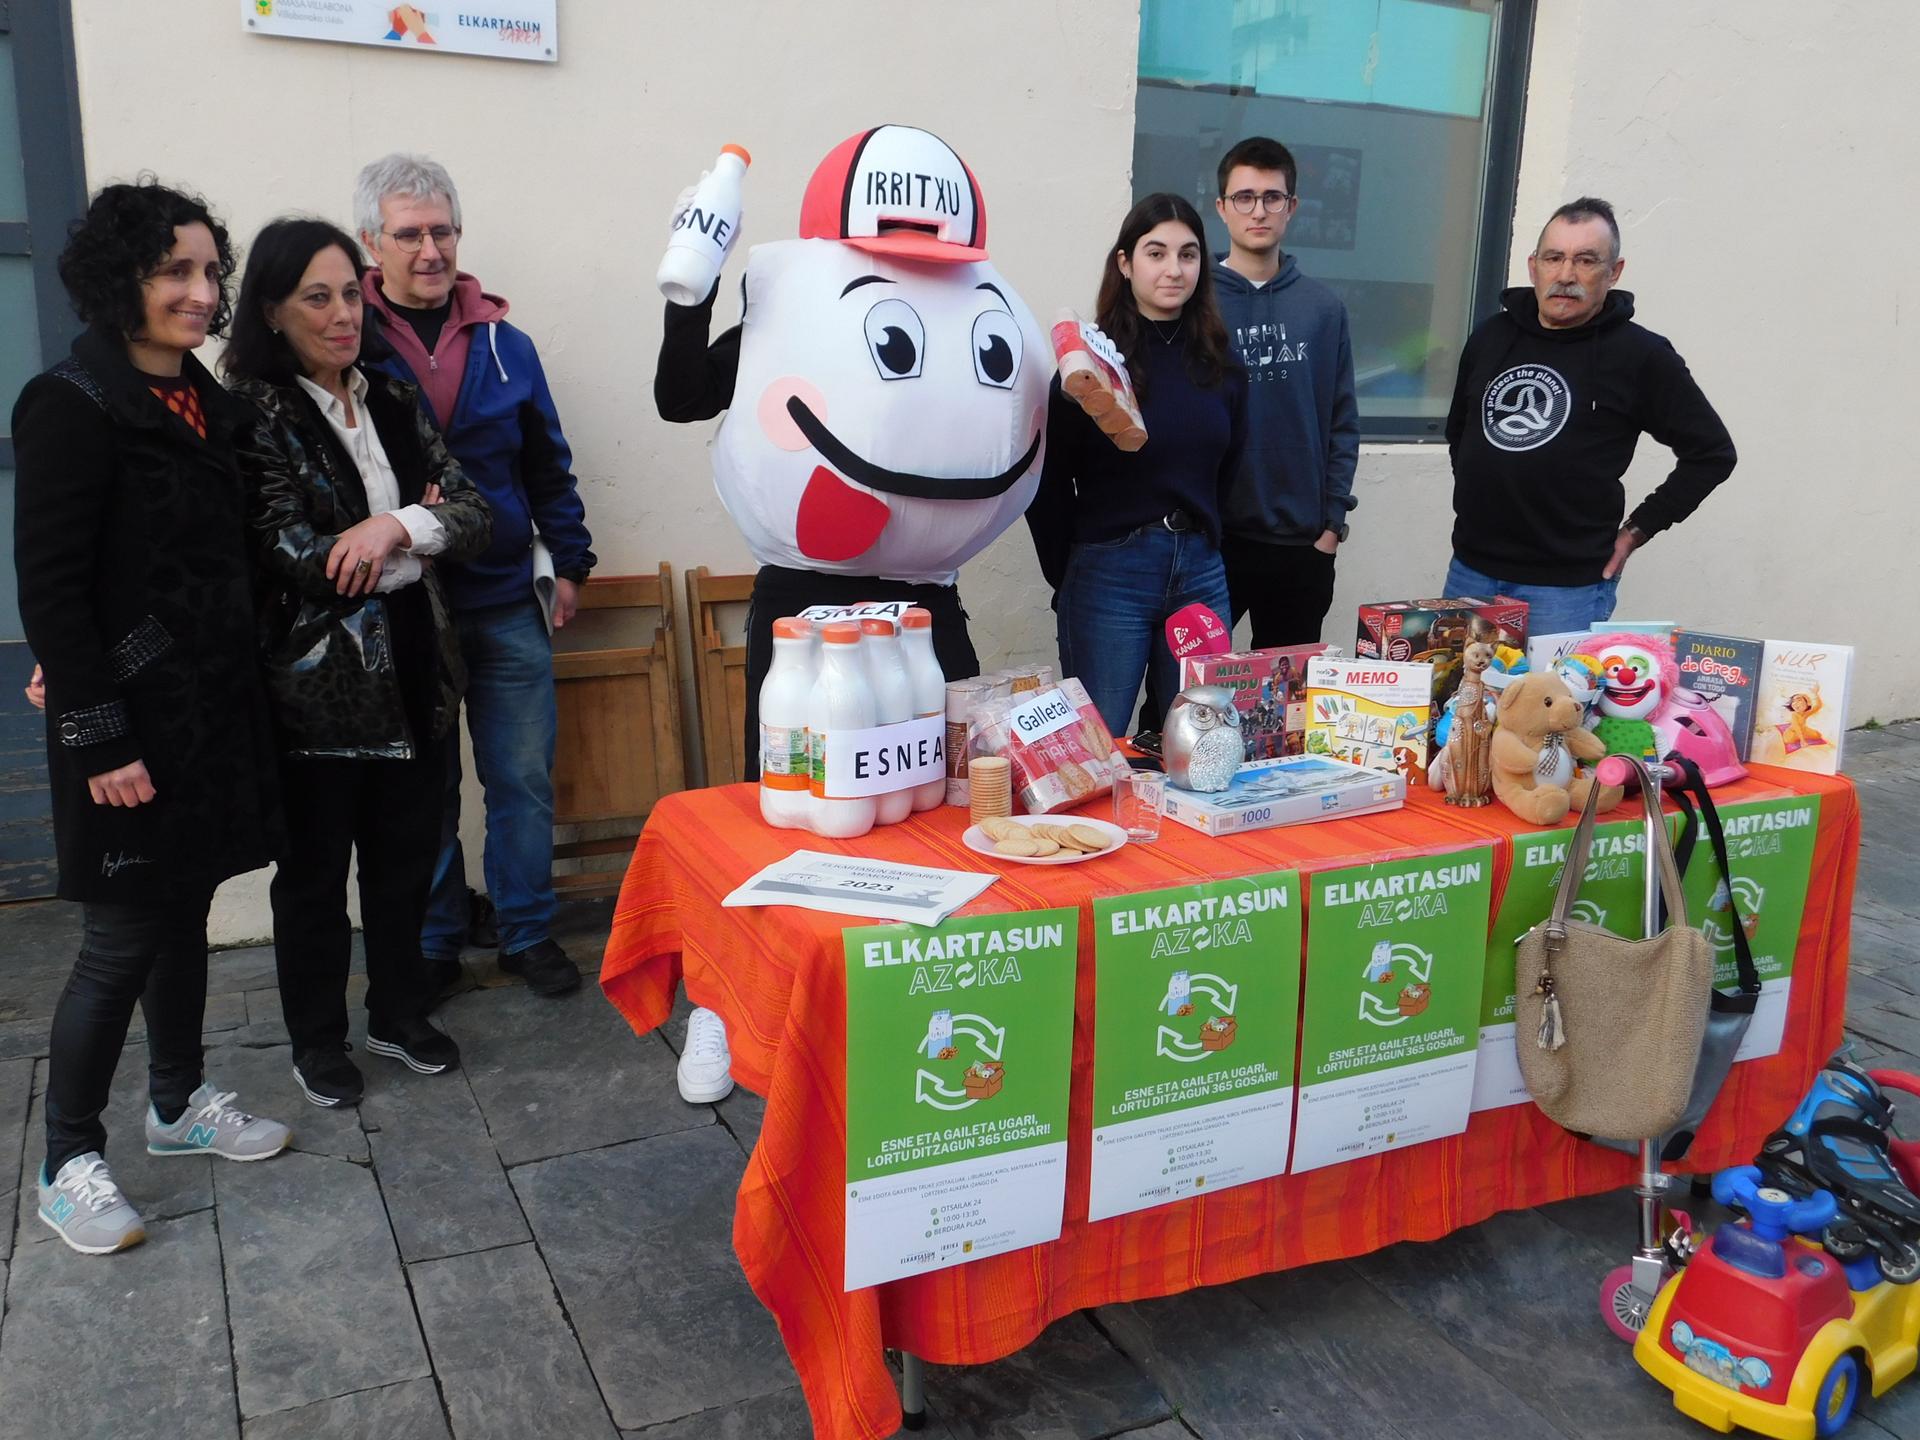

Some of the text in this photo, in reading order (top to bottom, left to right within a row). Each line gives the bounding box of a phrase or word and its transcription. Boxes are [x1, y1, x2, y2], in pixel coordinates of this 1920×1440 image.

[458, 14, 541, 33] ELKARTASUN
[866, 171, 960, 216] IRRITXU
[1487, 369, 1562, 425] we protect the planet
[1175, 637, 1204, 656] KANALA
[1691, 643, 1736, 659] DIARIO
[1773, 651, 1827, 670] NUR
[1216, 663, 1252, 677] MILA
[1346, 671, 1398, 684] MEMO
[1681, 655, 1699, 672] de
[1700, 657, 1741, 685] Greg
[1696, 675, 1723, 685] ARRASA
[1692, 682, 1725, 693] CON TODO
[1017, 692, 1073, 732] Galletak
[855, 736, 943, 779] ESNEA
[1241, 807, 1271, 824] 1000
[838, 880, 894, 892] 2023
[1324, 862, 1481, 907] ELKARTASUN
[1111, 886, 1288, 936] ELKARTASUN
[863, 924, 1063, 967] ELKARTASUN
[1316, 1060, 1352, 1075] LORTU
[1352, 1048, 1405, 1067] DITZAGUN
[1406, 1044, 1425, 1056] 365
[1328, 1027, 1455, 1062] ESNE ETA GAILETA UGARI,
[1124, 1062, 1267, 1101] ESNE ETA GAILETA UGARI,
[1111, 1098, 1150, 1115] LORTU
[1152, 1086, 1210, 1106] DITZAGUN
[1211, 1081, 1233, 1094] 365
[185, 1122, 217, 1147] N
[867, 1124, 1050, 1168] LORTU DITZAGUN 365 GOSARI!!
[881, 1114, 1038, 1152] ESNE ETA GAILETA UGARI,
[50, 1194, 76, 1225] N
[940, 1198, 982, 1213] OTSAILAK 24
[934, 1218, 987, 1235] BERDURA PLAZA
